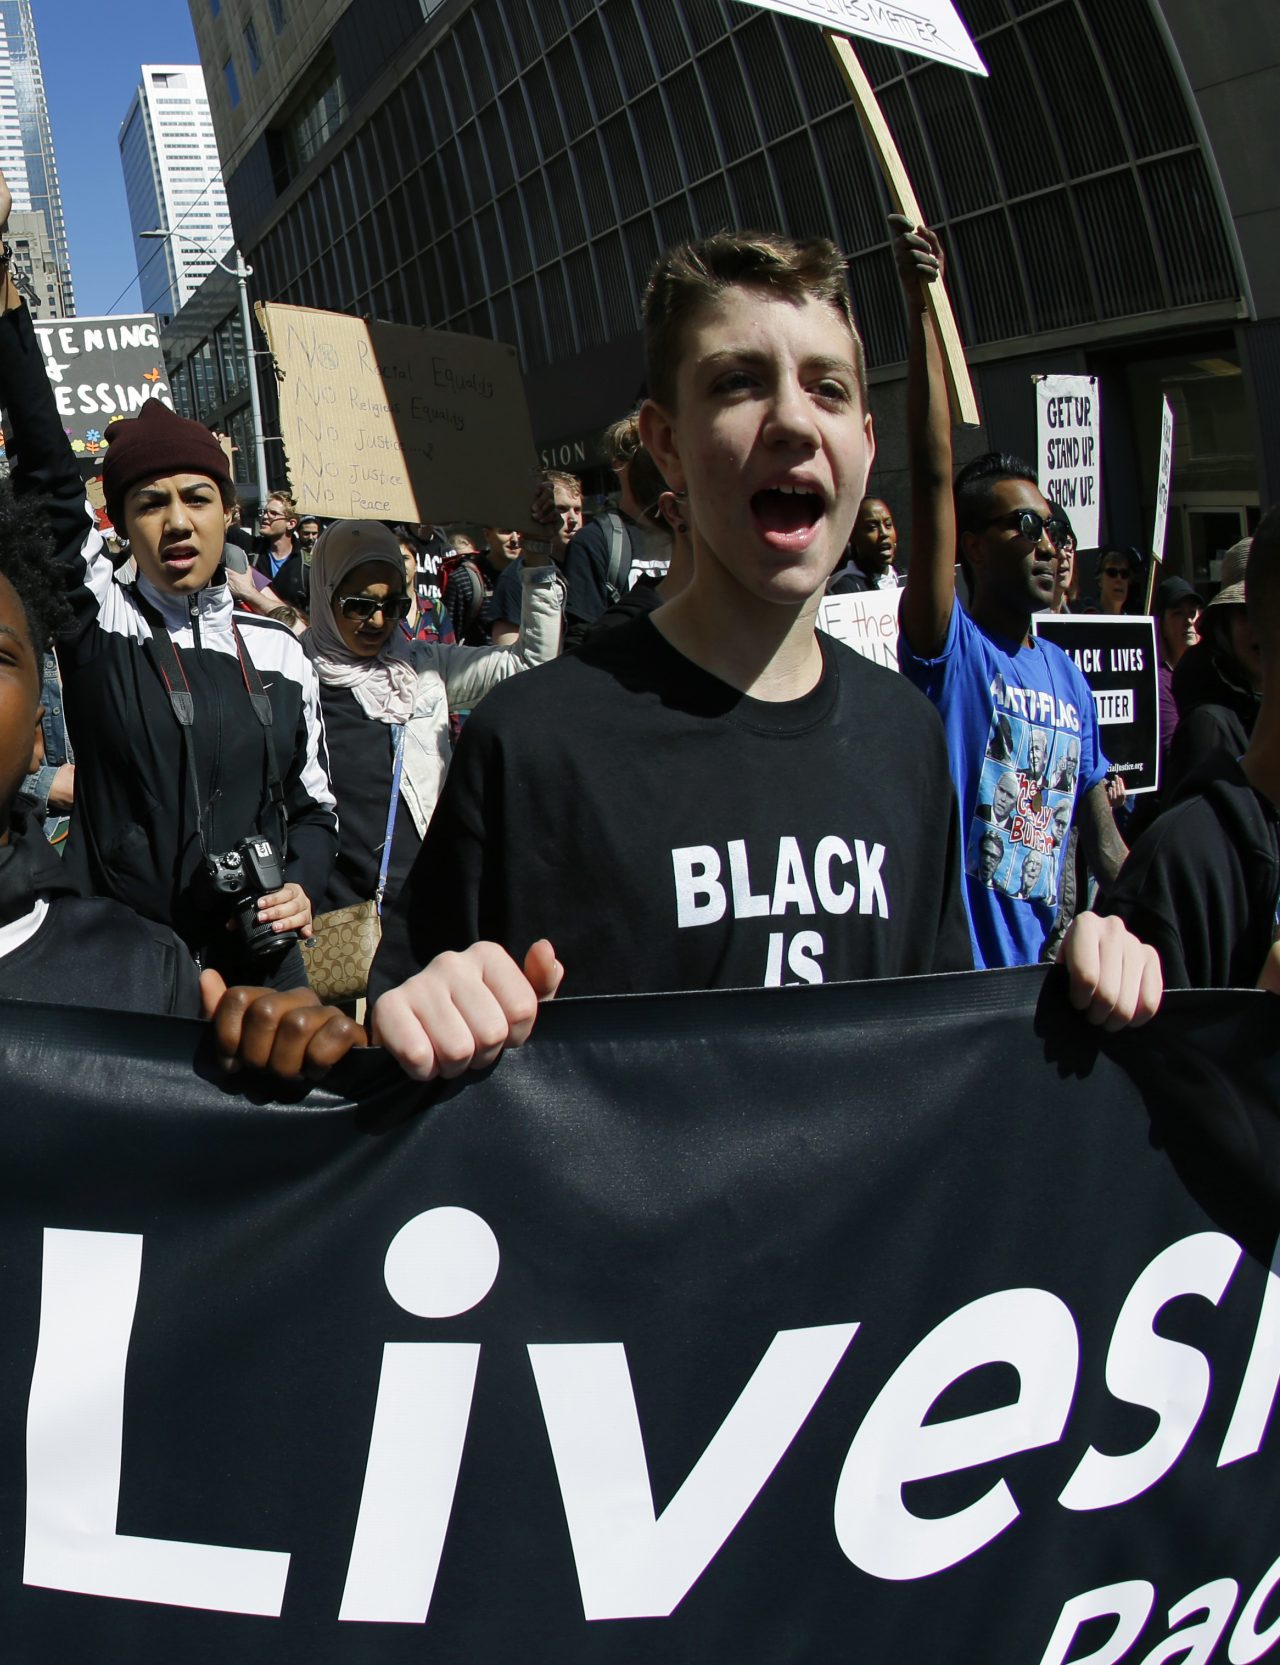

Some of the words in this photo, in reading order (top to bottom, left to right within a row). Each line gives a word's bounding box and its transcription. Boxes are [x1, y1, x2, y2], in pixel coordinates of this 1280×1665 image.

[1047, 397, 1074, 429] GET
[1075, 396, 1092, 428] UP.
[1047, 437, 1080, 470] STAND
[1082, 436, 1095, 468] UP.
[350, 490, 391, 517] Peace
[1047, 475, 1078, 508] SHOW
[1079, 475, 1095, 507] UP.
[1065, 649, 1102, 673] ACK
[1111, 648, 1144, 672] LIVES
[989, 672, 1081, 734] ANTI-FLAG
[671, 834, 889, 929] BLACK
[763, 930, 824, 988] IS
